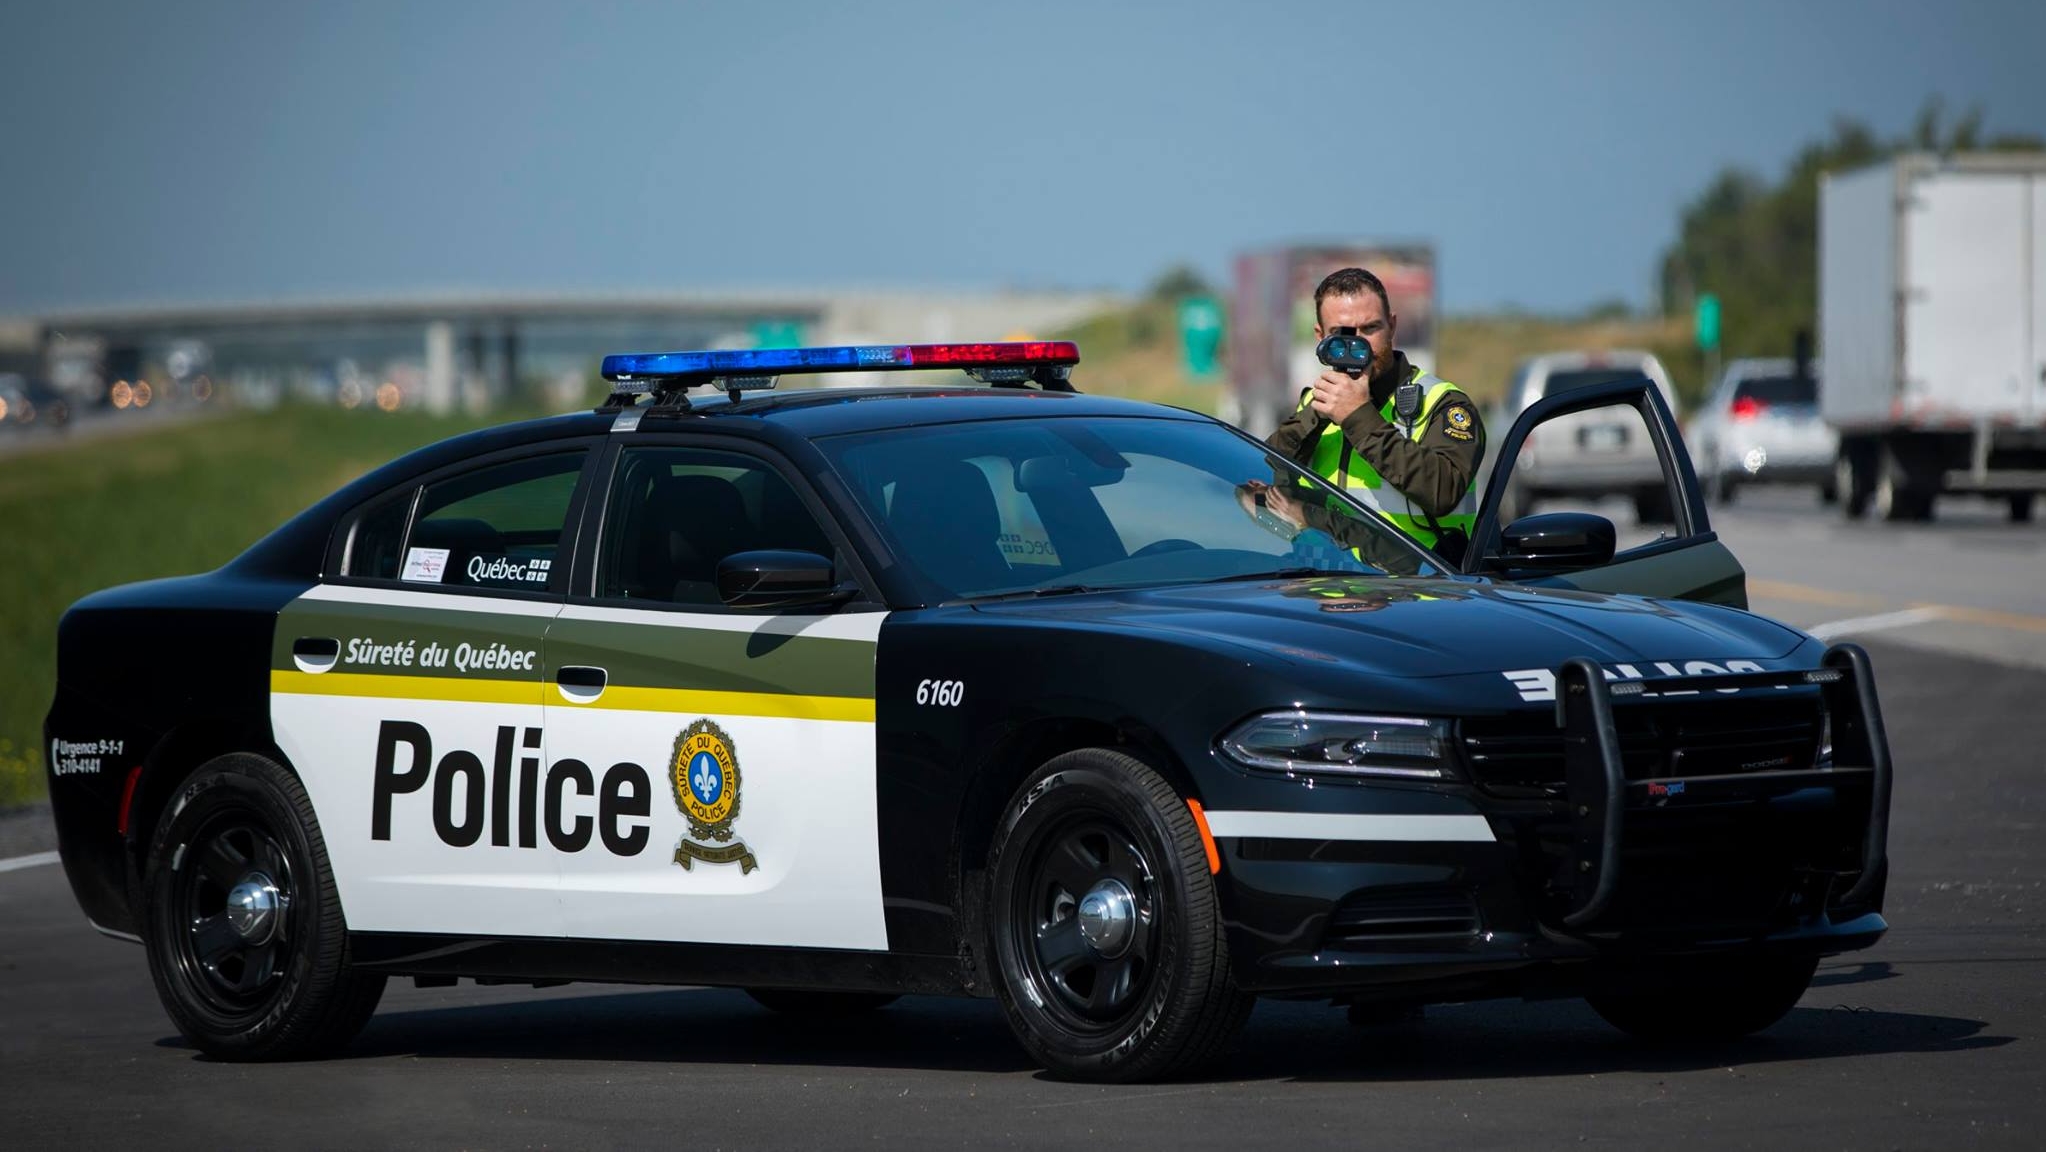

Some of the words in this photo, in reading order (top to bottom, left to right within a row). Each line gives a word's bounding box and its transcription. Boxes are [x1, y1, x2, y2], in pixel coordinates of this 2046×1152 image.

[467, 555, 526, 582] Québec
[345, 637, 416, 666] Sûreté
[420, 642, 449, 667] du
[454, 642, 536, 673] Québec
[916, 678, 964, 707] 6160
[60, 740, 98, 758] Urgence
[99, 739, 123, 755] 9-1-1
[697, 737, 710, 748] DU
[61, 758, 101, 773] 310-4141
[371, 719, 651, 857] Police
[690, 800, 726, 820] POLICE
